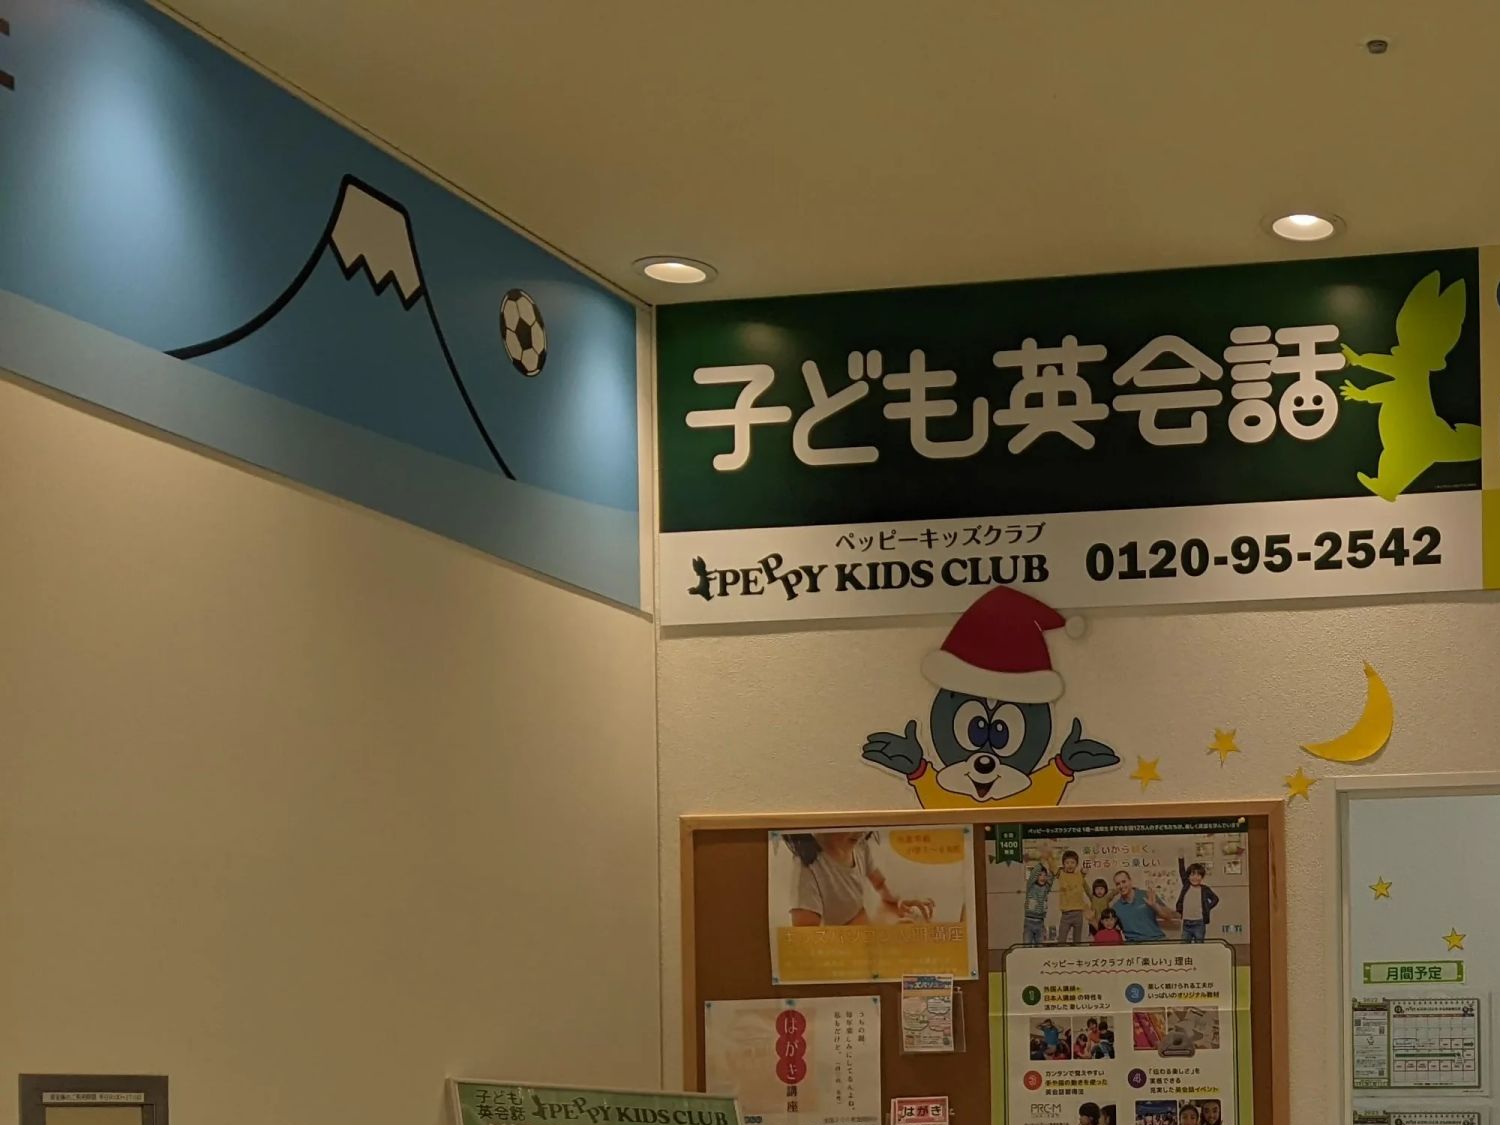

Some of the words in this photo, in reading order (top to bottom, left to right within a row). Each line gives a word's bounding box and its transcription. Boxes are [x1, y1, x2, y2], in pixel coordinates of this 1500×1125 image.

[685, 324, 1344, 472] 子ども英会話
[835, 521, 1047, 552] ペッピーキッズクラブ
[1086, 525, 1443, 583] 0120-95-2542
[715, 551, 828, 602] PEPPY
[835, 558, 933, 592] KIDS
[940, 551, 1050, 586] CLUB
[1000, 841, 1018, 849] 1400
[1386, 966, 1443, 981] 月間予定
[476, 1089, 523, 1106] 子ども
[478, 1104, 525, 1122] 英会話
[549, 1096, 612, 1125] PEPPY
[615, 1105, 670, 1125] KIDS
[904, 1105, 943, 1118] はがき
